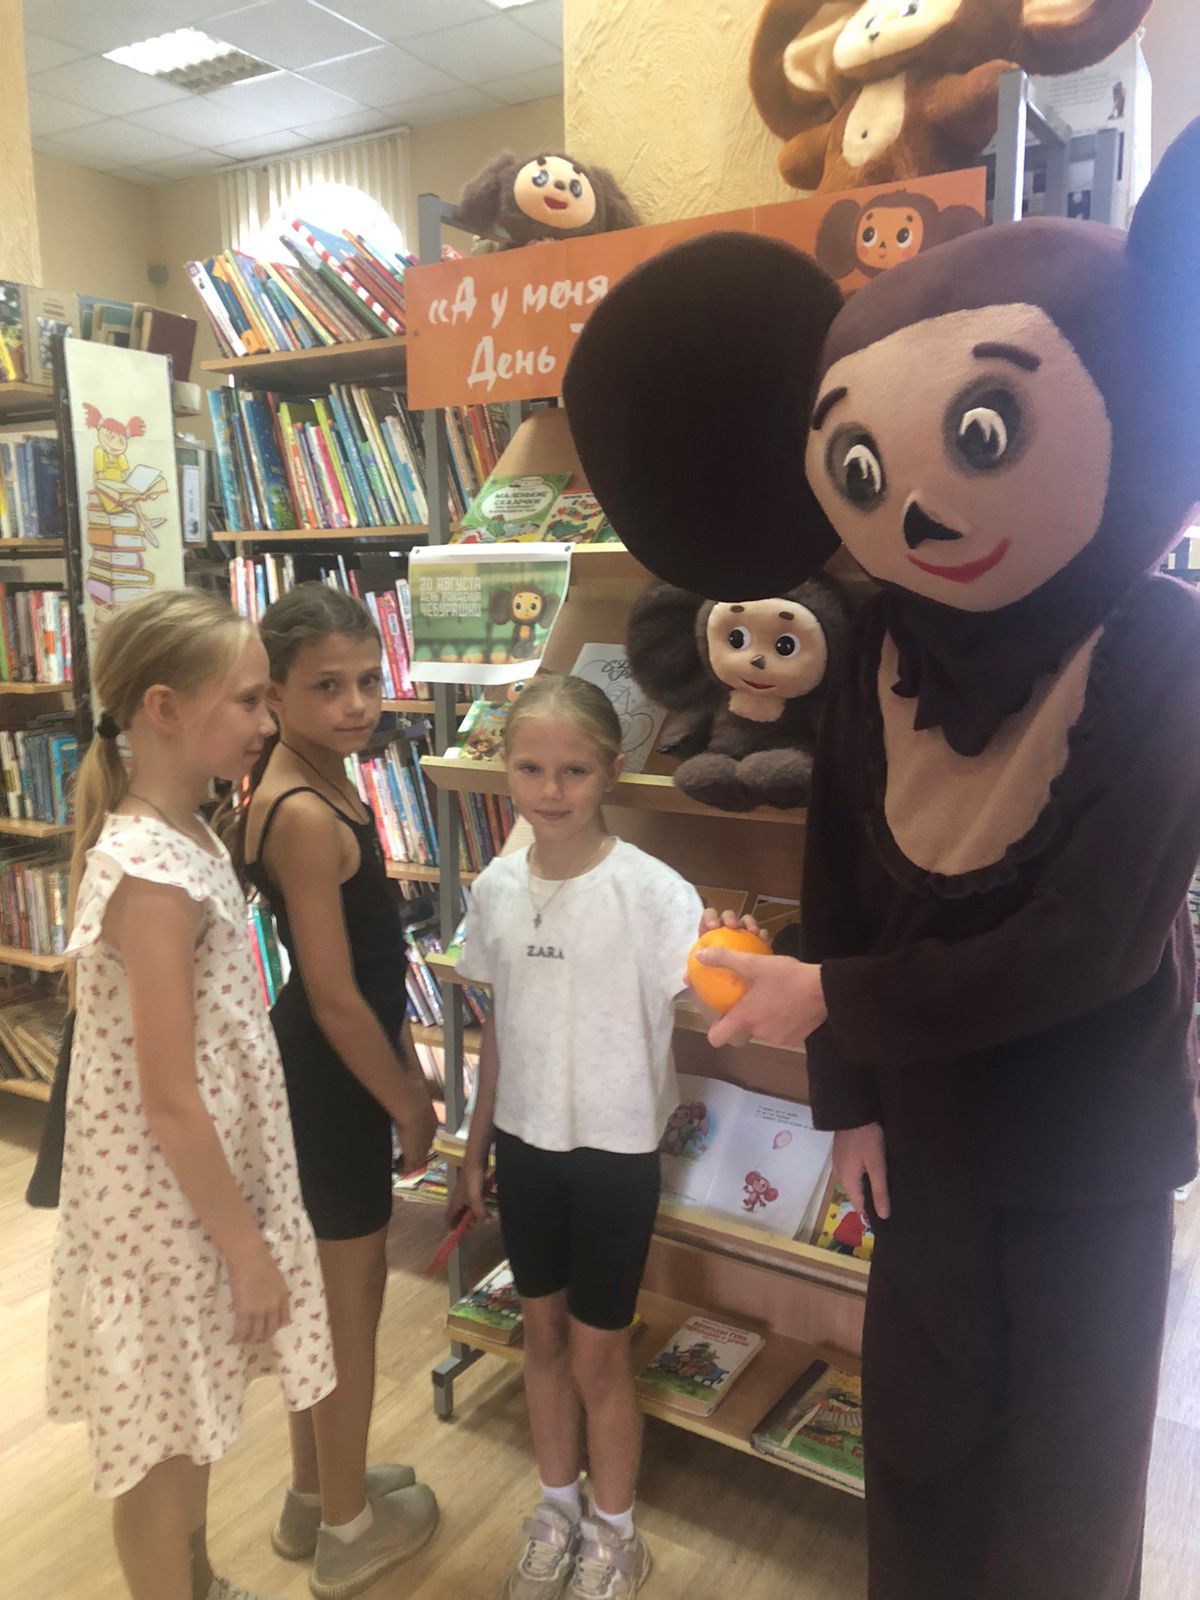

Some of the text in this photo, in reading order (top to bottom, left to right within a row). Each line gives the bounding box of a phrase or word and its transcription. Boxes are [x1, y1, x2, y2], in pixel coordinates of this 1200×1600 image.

[491, 287, 509, 329] у
[467, 336, 557, 393] День
[419, 576, 482, 592] 20 АВГУСТА
[420, 591, 440, 602] ДЕНЬ
[420, 602, 482, 617] ЧЕБУРАШКИ
[526, 945, 565, 960] ZARA
